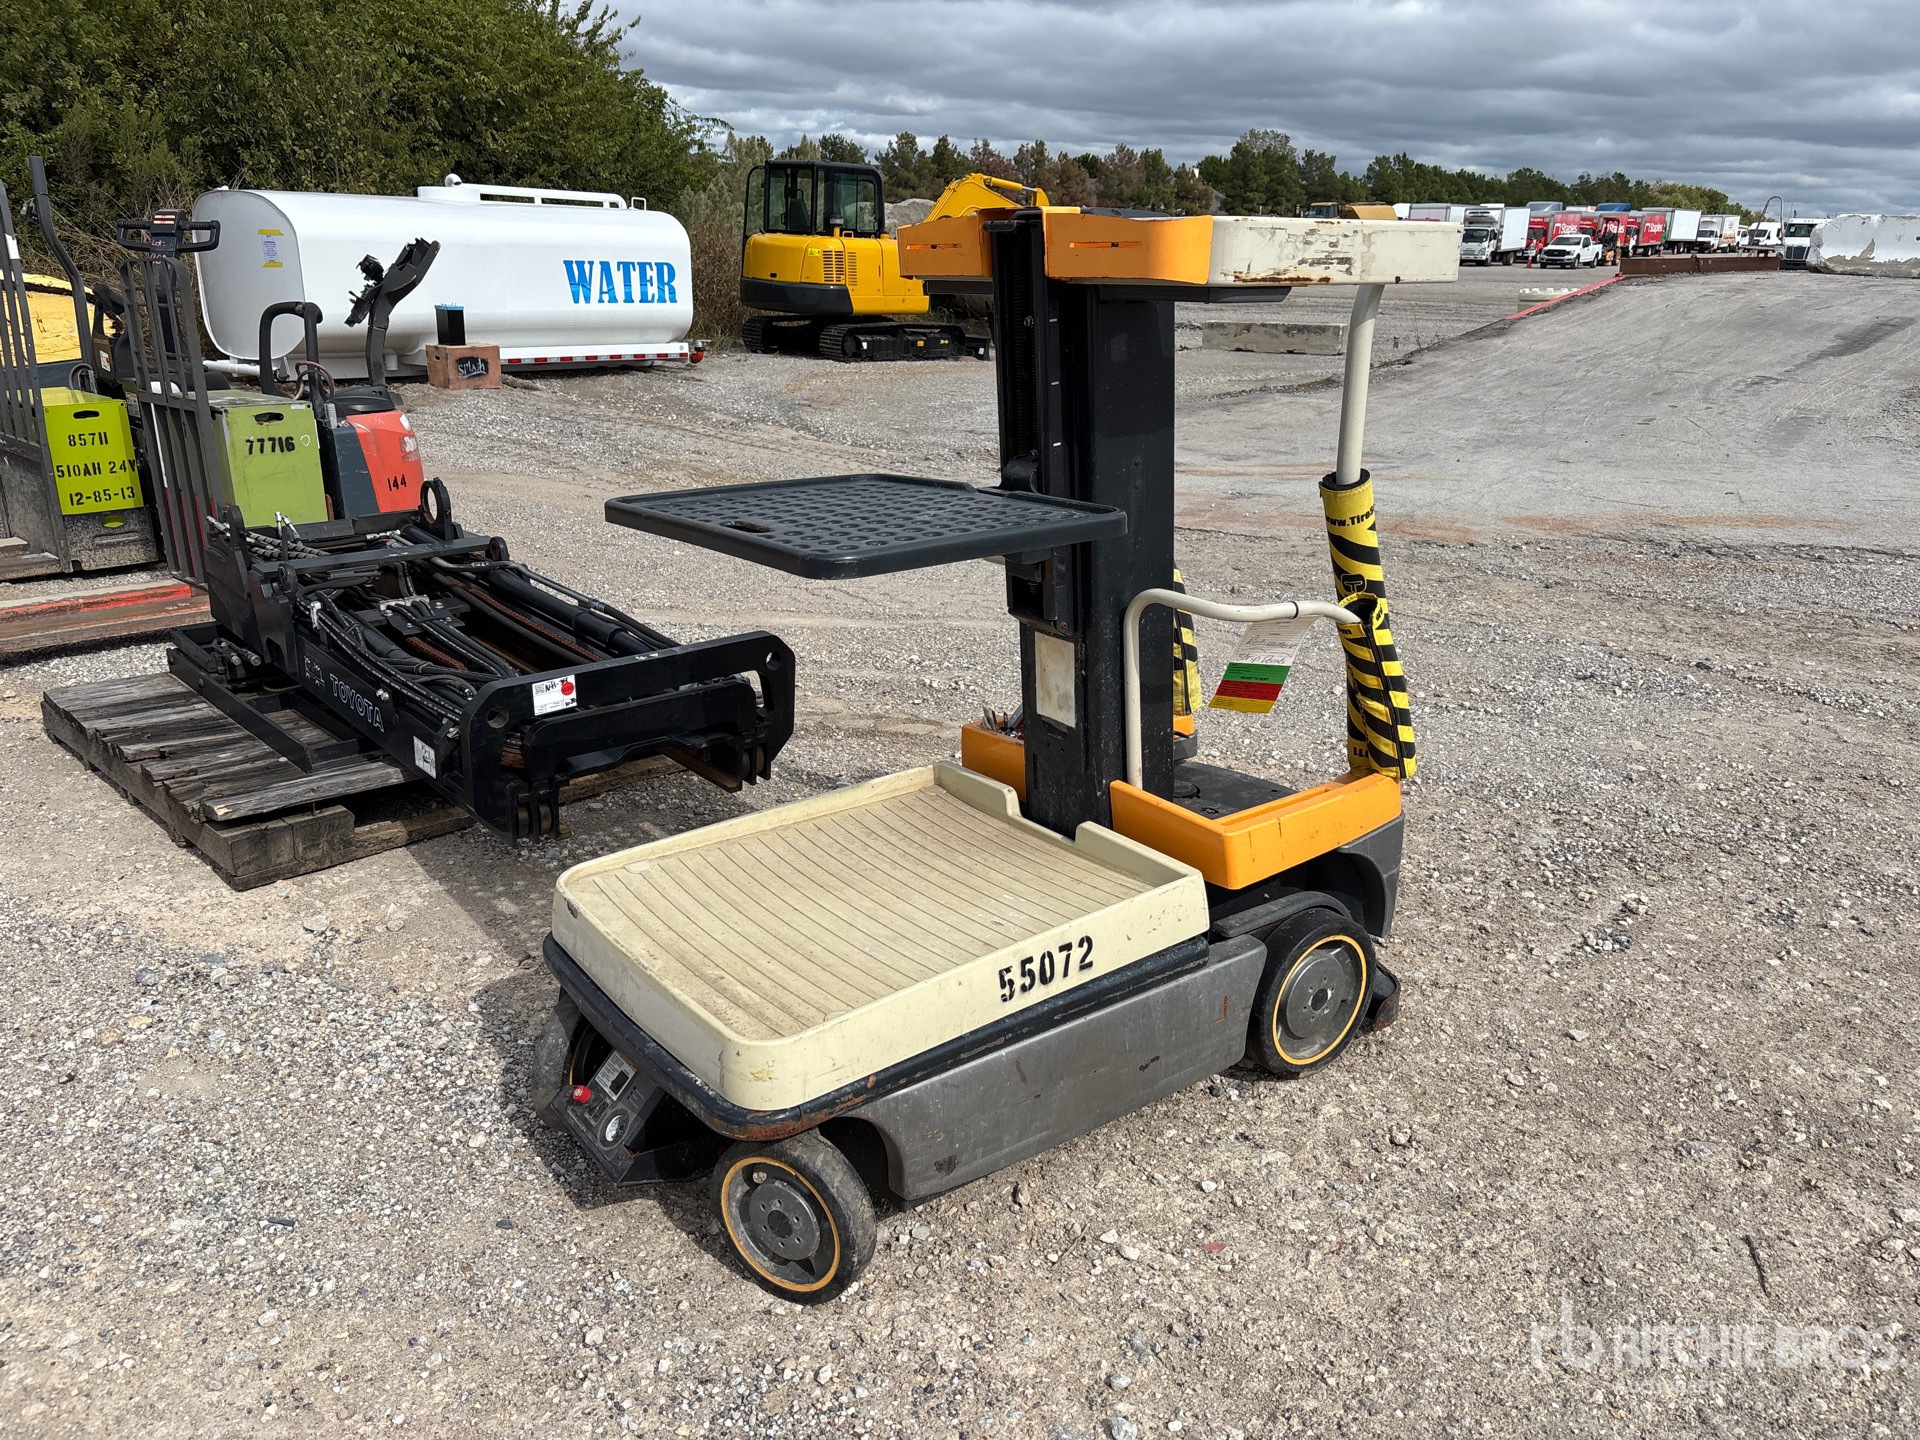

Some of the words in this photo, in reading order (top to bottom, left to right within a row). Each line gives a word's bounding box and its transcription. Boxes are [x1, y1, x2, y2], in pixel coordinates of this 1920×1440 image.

[562, 259, 678, 305] WATER
[67, 431, 109, 447] 85711
[245, 435, 296, 456] 77716
[108, 459, 137, 474] 24V
[387, 473, 407, 492] 144
[69, 485, 136, 507] 12-85-13
[329, 672, 385, 734] TOYOTA
[998, 934, 1095, 1003] 55072
